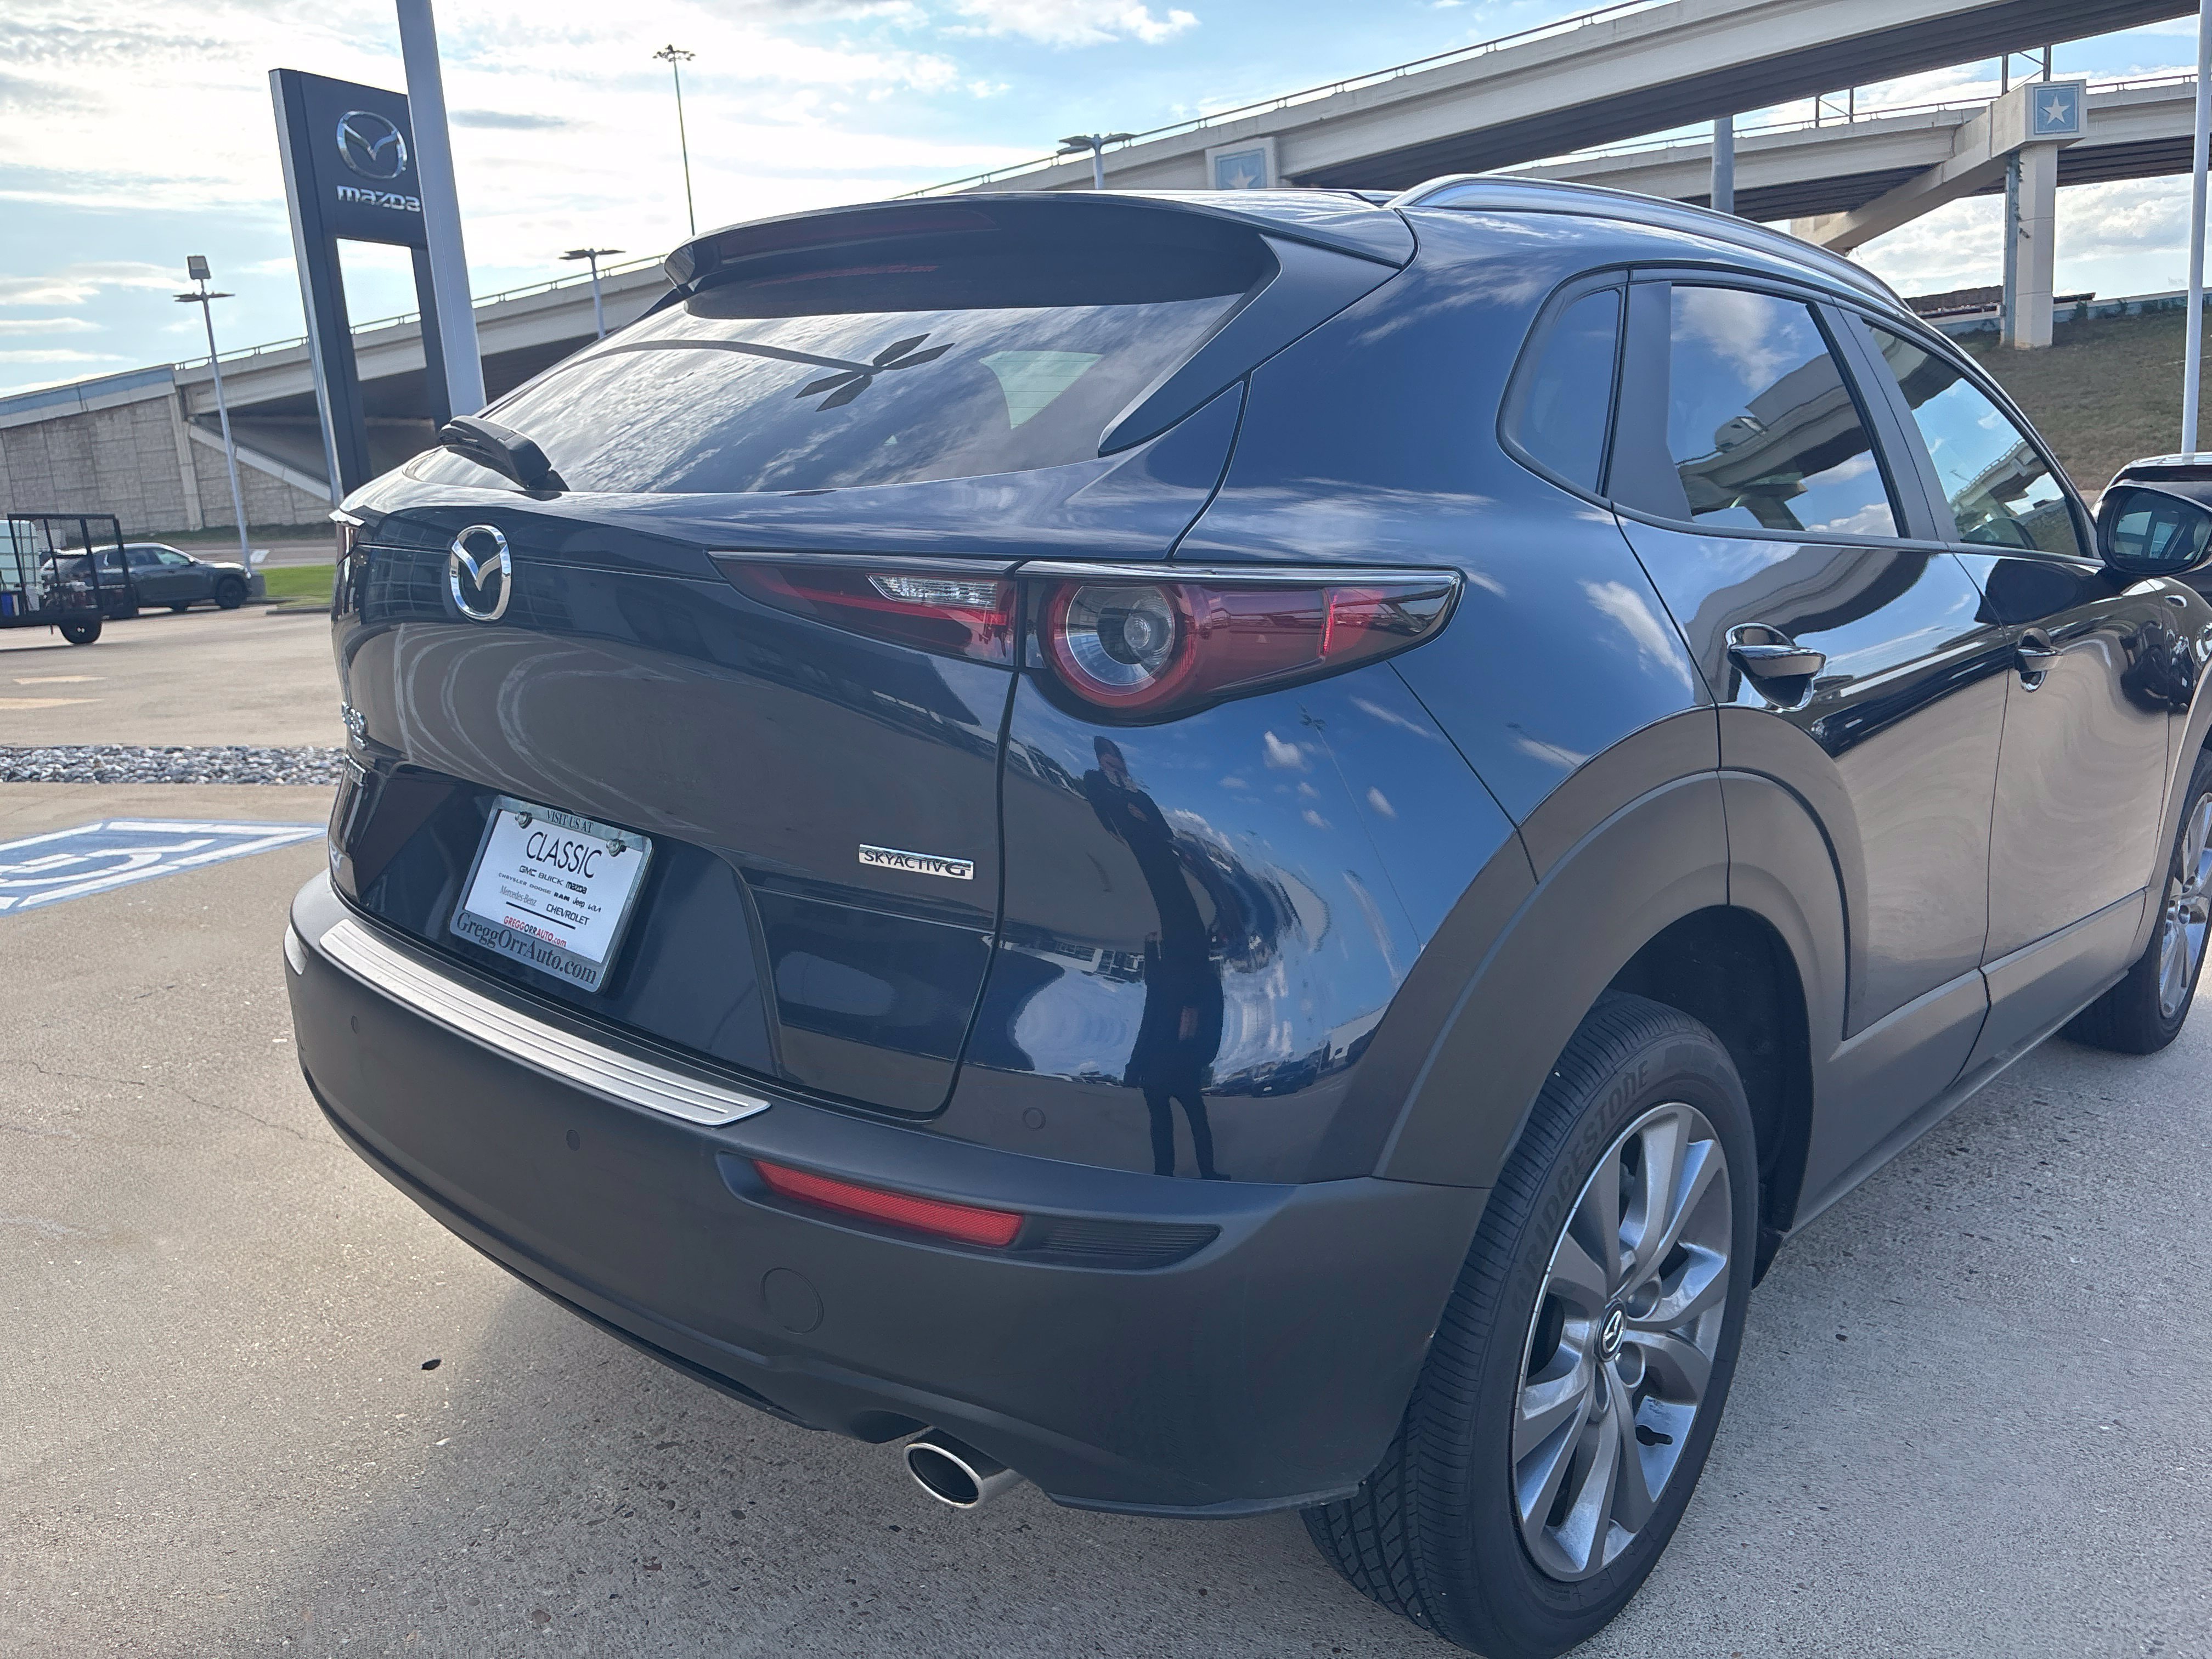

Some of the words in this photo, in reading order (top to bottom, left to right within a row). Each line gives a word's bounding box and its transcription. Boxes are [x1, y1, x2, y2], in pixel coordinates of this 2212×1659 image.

[336, 185, 421, 212] mazda
[547, 809, 568, 826] VISIT
[569, 816, 580, 830] US
[581, 821, 594, 833] AT
[526, 831, 602, 878] CLASSIC
[498, 872, 527, 886] CHRYSLER
[529, 884, 552, 895] DODGE
[554, 892, 571, 902] RAM
[572, 896, 585, 909] Jeep
[519, 865, 538, 877] GMC
[538, 872, 565, 886] BUICK
[566, 881, 588, 895] mazda
[499, 884, 538, 907] Mercedes-Benz
[546, 903, 590, 926] CHEVROLET
[503, 916, 567, 947] GREGGORRAUTO.com
[456, 912, 598, 985] GreggOrrAuto.com
